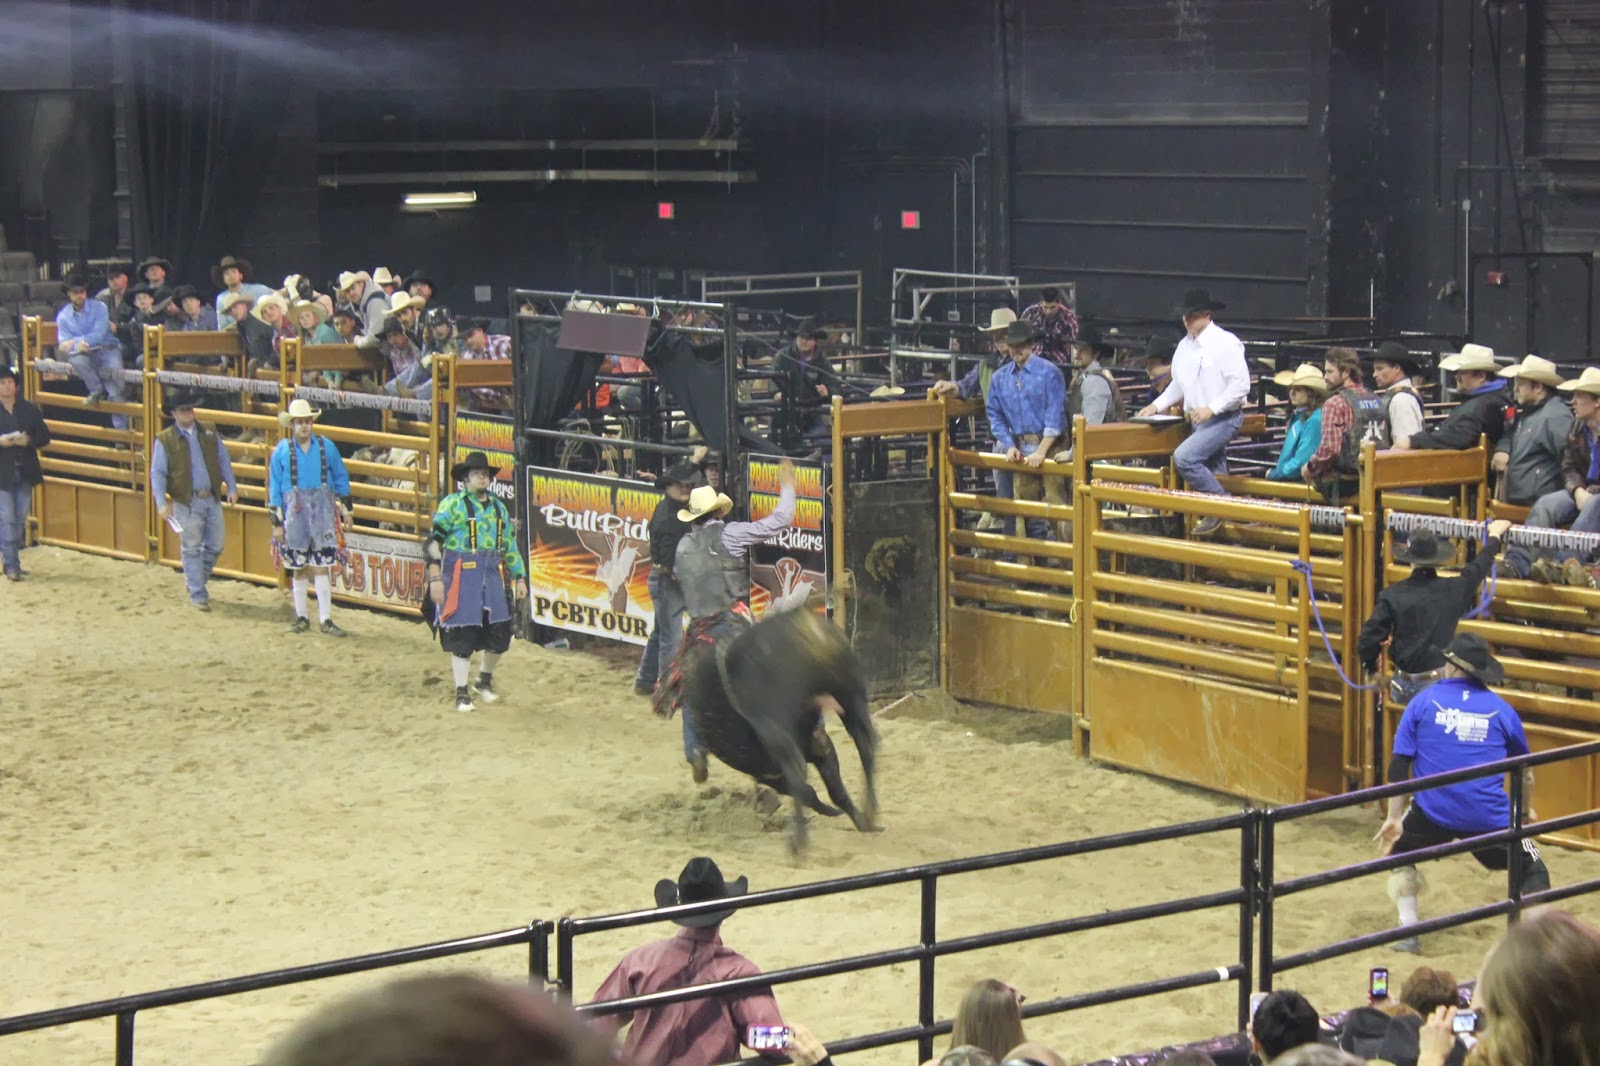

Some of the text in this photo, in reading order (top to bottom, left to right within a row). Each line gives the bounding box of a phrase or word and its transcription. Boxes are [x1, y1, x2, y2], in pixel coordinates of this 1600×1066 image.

[532, 475, 614, 515] PROFESSIONAL
[367, 554, 426, 602] TOUR
[535, 596, 649, 638] PCBTOUR
